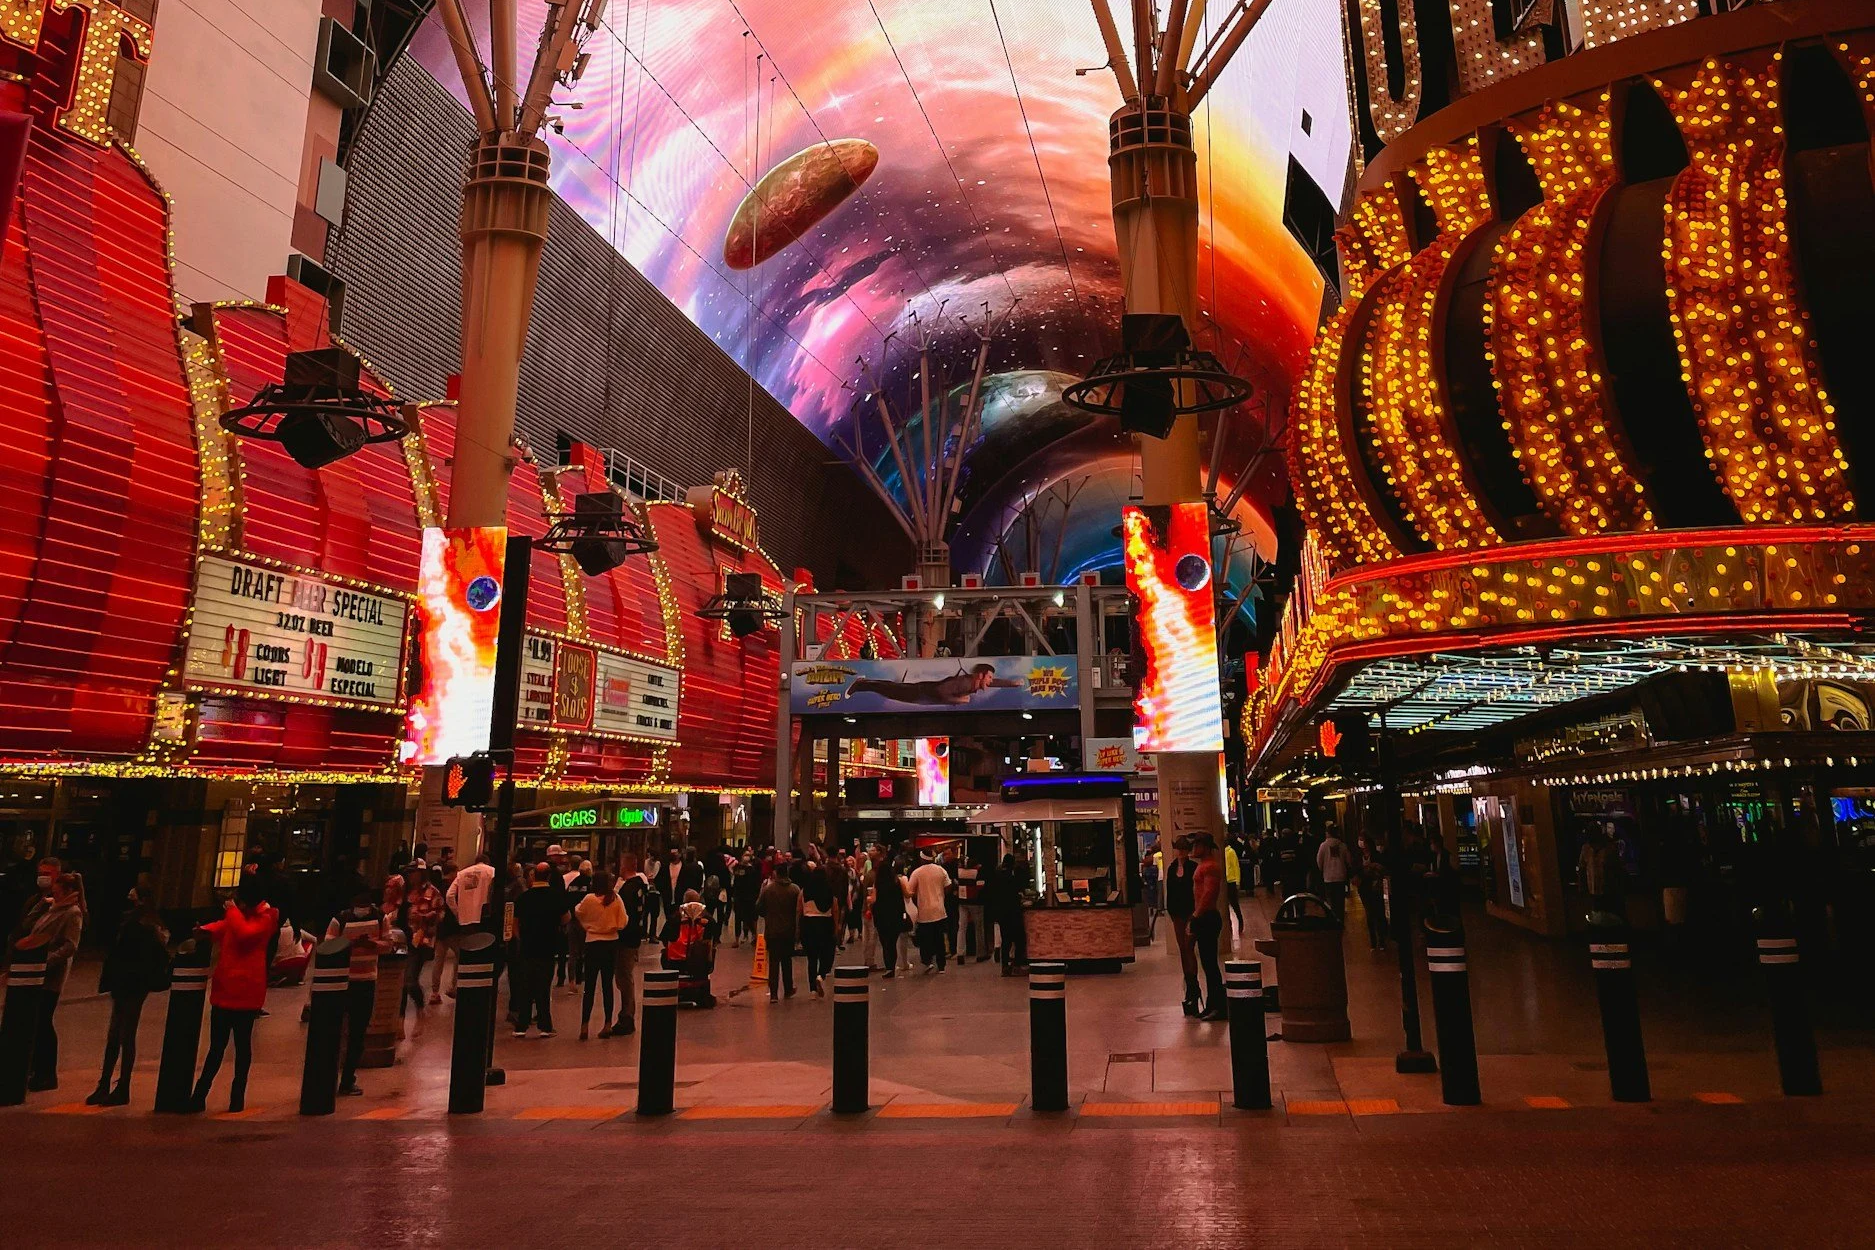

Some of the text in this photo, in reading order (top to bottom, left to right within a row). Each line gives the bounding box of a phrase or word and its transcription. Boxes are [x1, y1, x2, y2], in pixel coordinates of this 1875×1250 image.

[231, 565, 384, 626] DRAFT BEER SPECIAL
[309, 618, 334, 637] BEER
[256, 643, 291, 664] COORS
[254, 666, 288, 687] LIGHT
[336, 656, 374, 677] MODELO
[562, 651, 591, 683] LOOSE
[330, 677, 376, 699] ESPECIAL
[560, 693, 588, 720] SLOTS
[1572, 788, 1623, 802] HYPNOSIS
[549, 809, 597, 829] CIGARS
